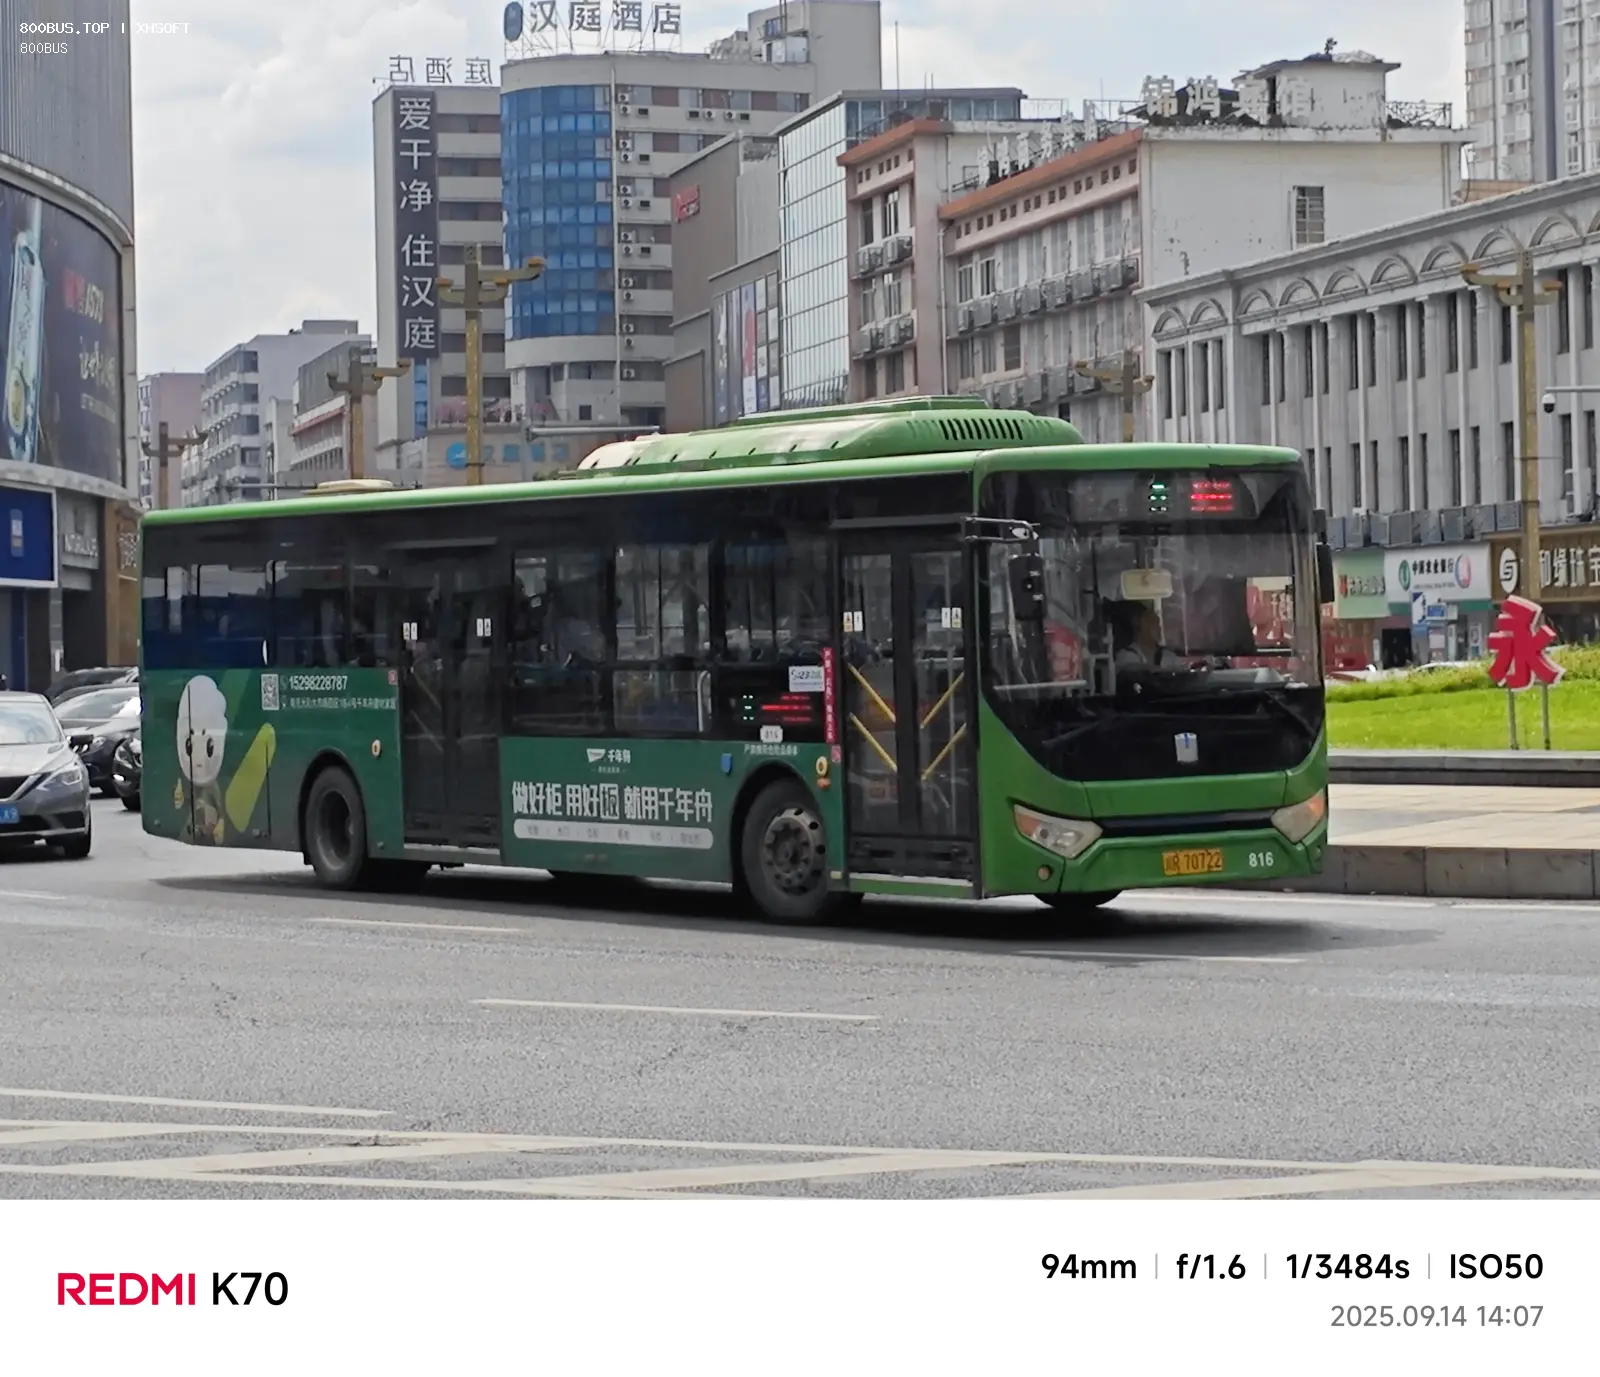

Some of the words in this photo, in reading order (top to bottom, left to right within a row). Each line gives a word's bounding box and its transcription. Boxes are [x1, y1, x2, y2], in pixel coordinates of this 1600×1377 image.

[530, 0, 681, 34] 汉庭酒店
[399, 97, 433, 213] 爱干净
[401, 233, 437, 350] 住汉庭
[1487, 595, 1567, 691] 永
[624, 785, 713, 823] 就用千年舟
[1248, 851, 1274, 868] 816
